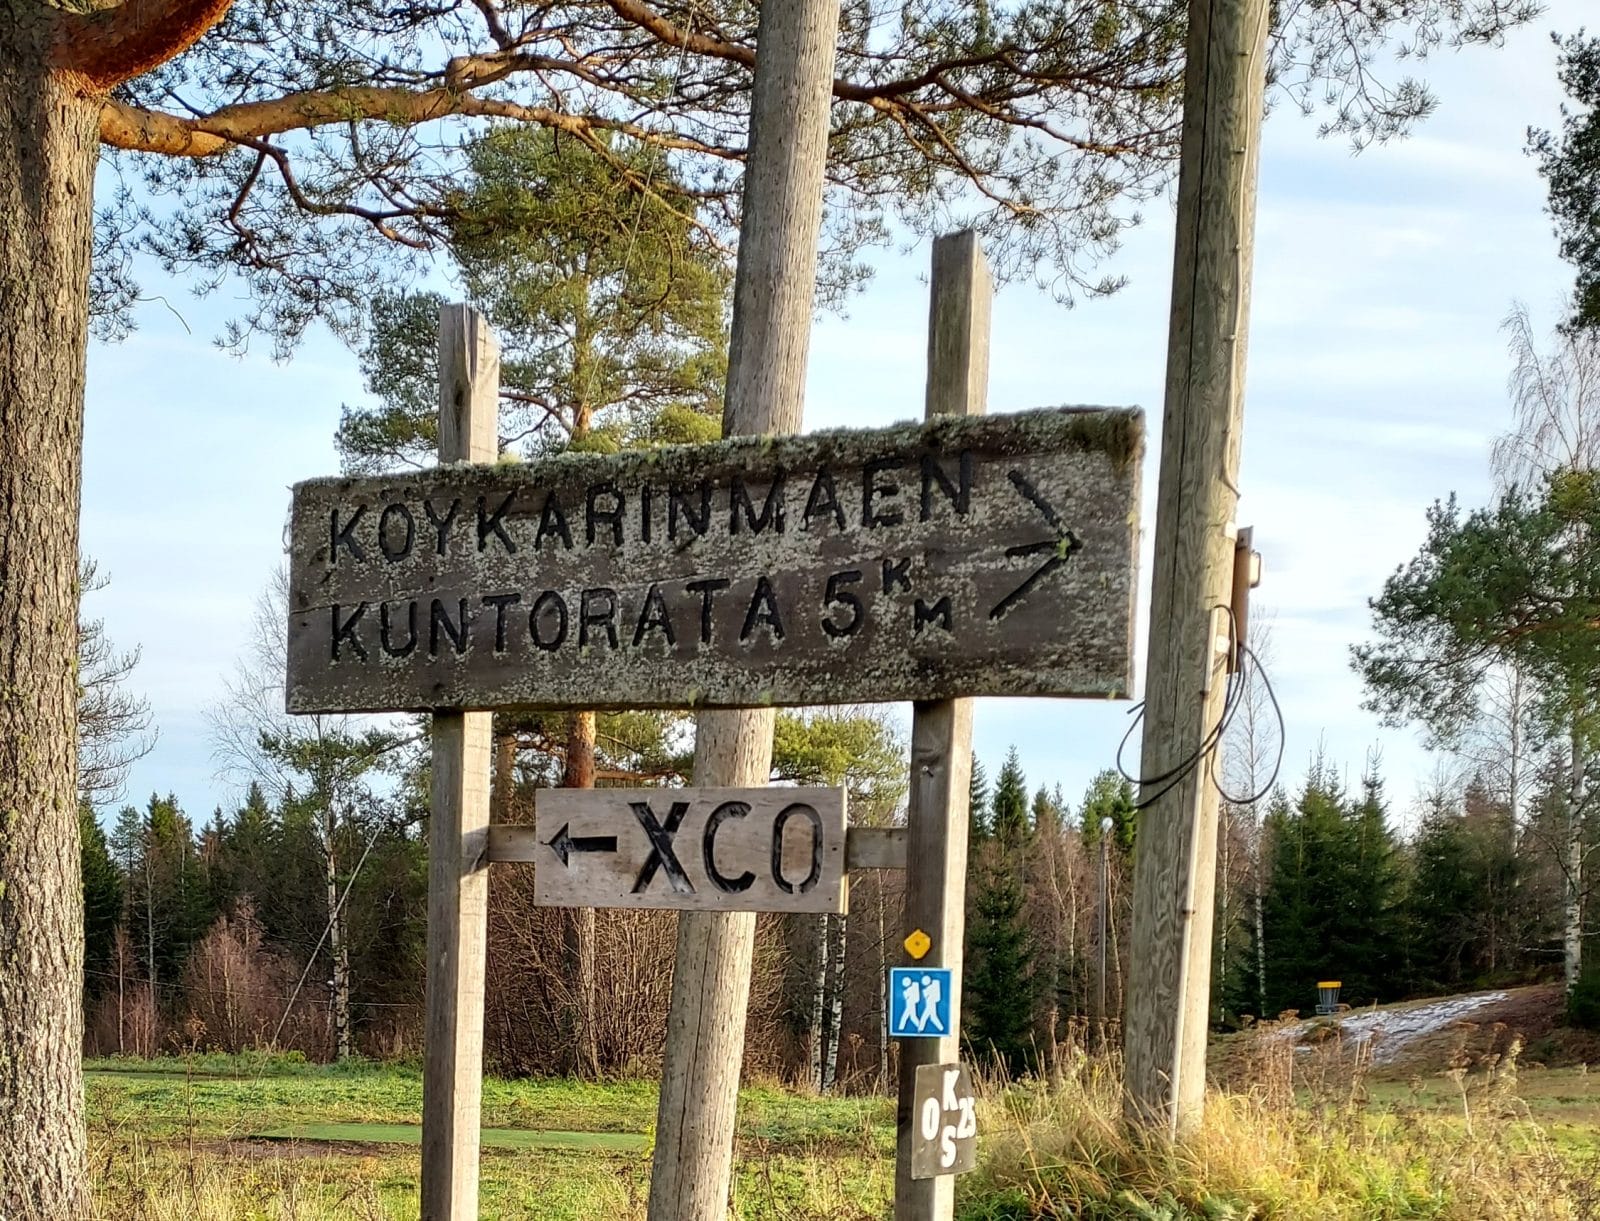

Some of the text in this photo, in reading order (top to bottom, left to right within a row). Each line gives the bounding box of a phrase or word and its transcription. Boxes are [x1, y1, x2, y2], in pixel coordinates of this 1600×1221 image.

[331, 579, 786, 661] KUNTORATA
[820, 570, 865, 638] 5
[627, 801, 824, 894] XCO
